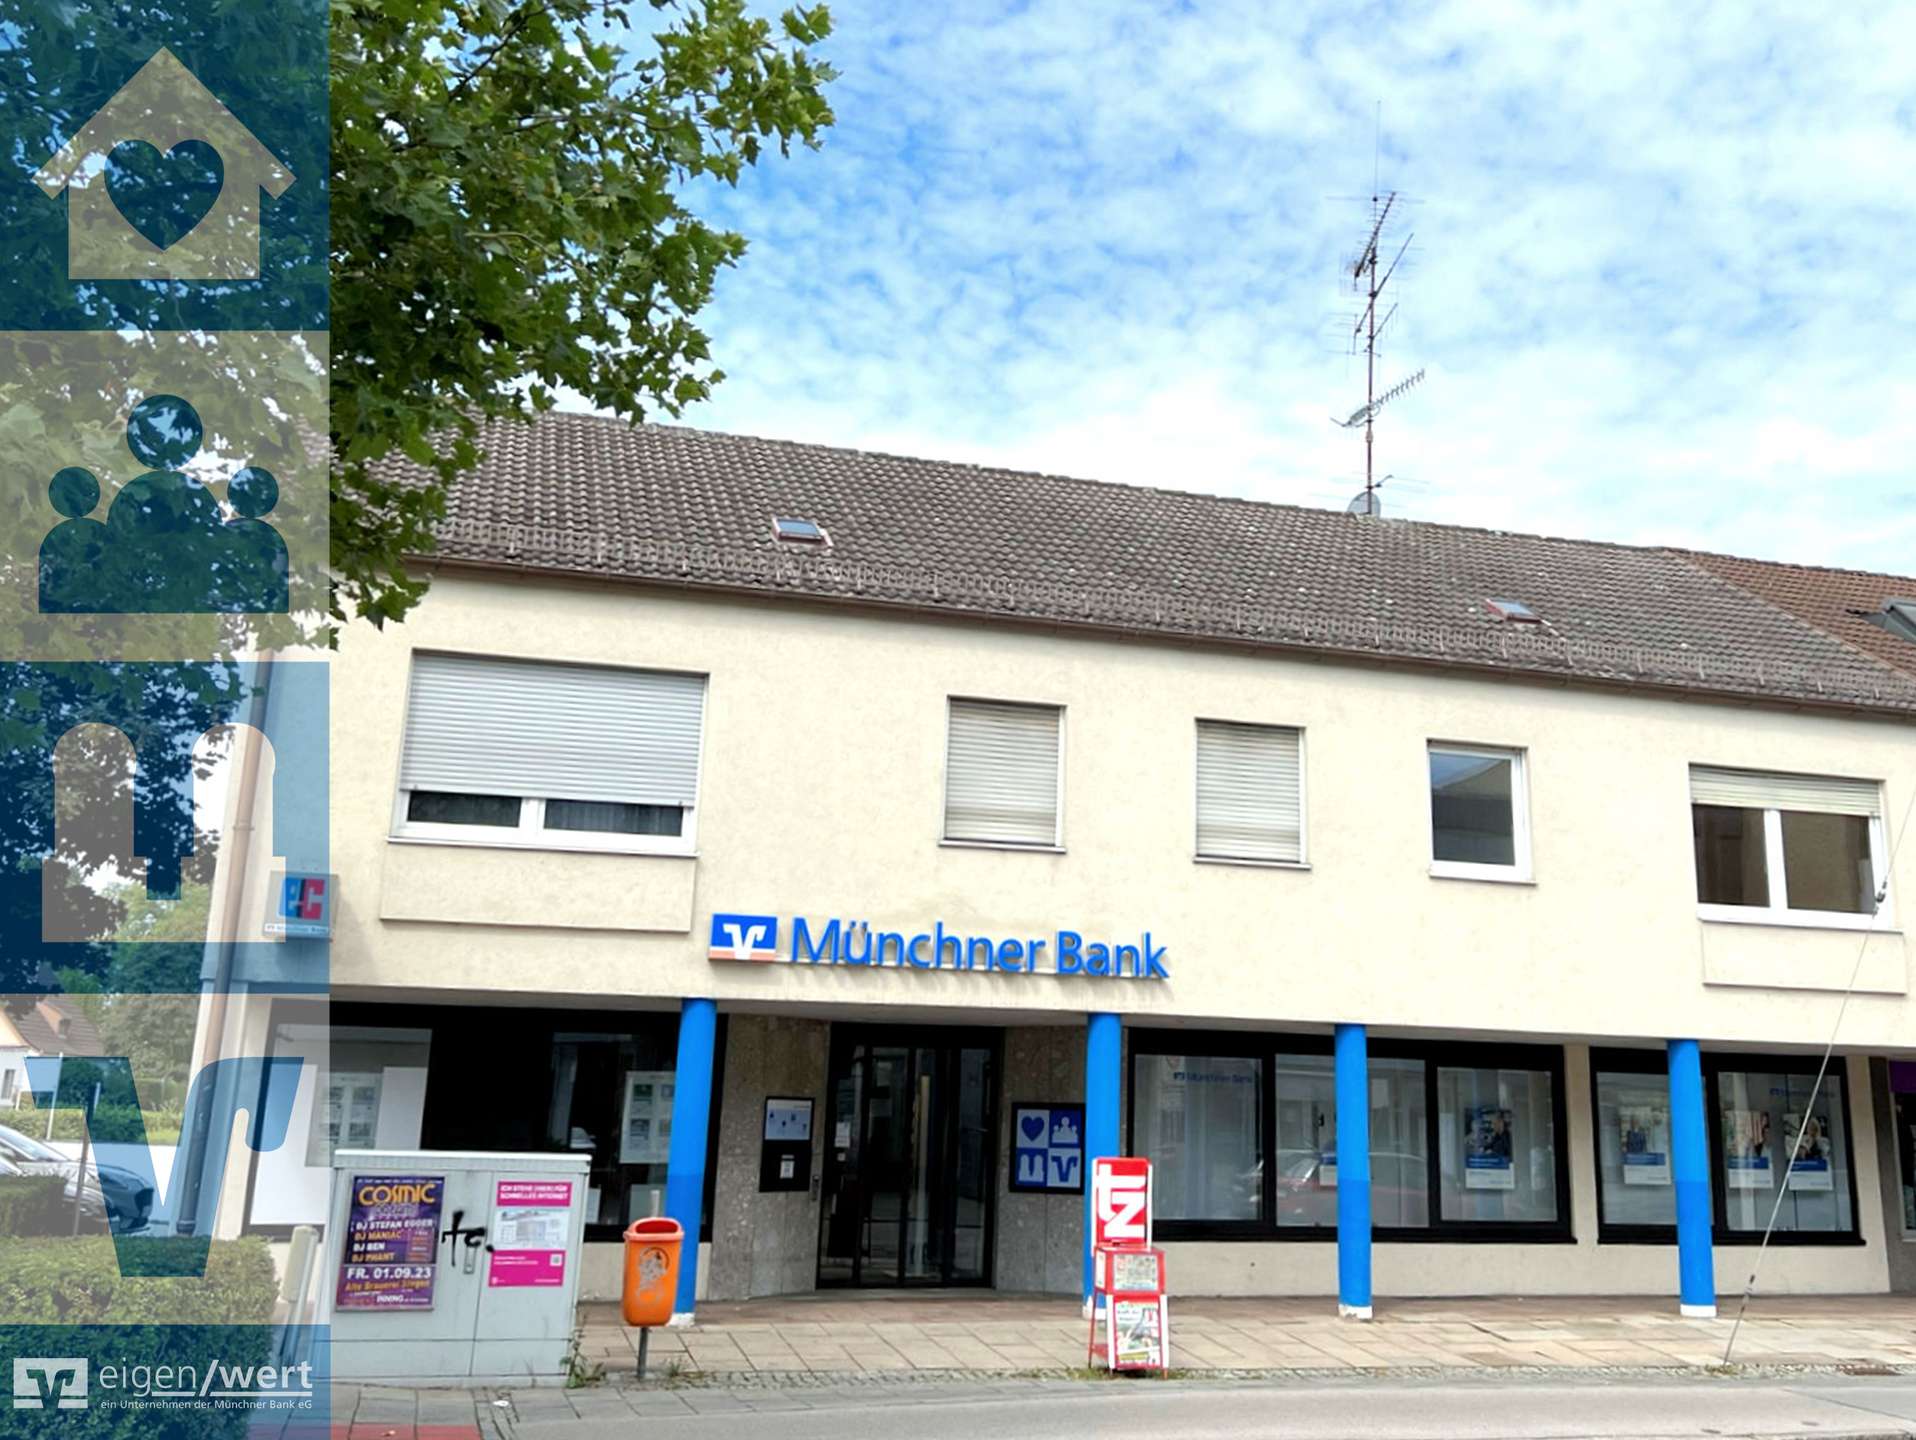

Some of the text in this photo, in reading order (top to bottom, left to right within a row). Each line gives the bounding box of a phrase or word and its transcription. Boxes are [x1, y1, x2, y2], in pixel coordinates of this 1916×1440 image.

[790, 917, 1169, 977] Münchner Bank
[359, 1184, 435, 1205] COSMIC
[1096, 1164, 1146, 1238] tz
[356, 1221, 368, 1230] DJ
[369, 1220, 402, 1229] STEFAN
[353, 1242, 365, 1251] DJ
[347, 1267, 432, 1280] FR. 01.09.23
